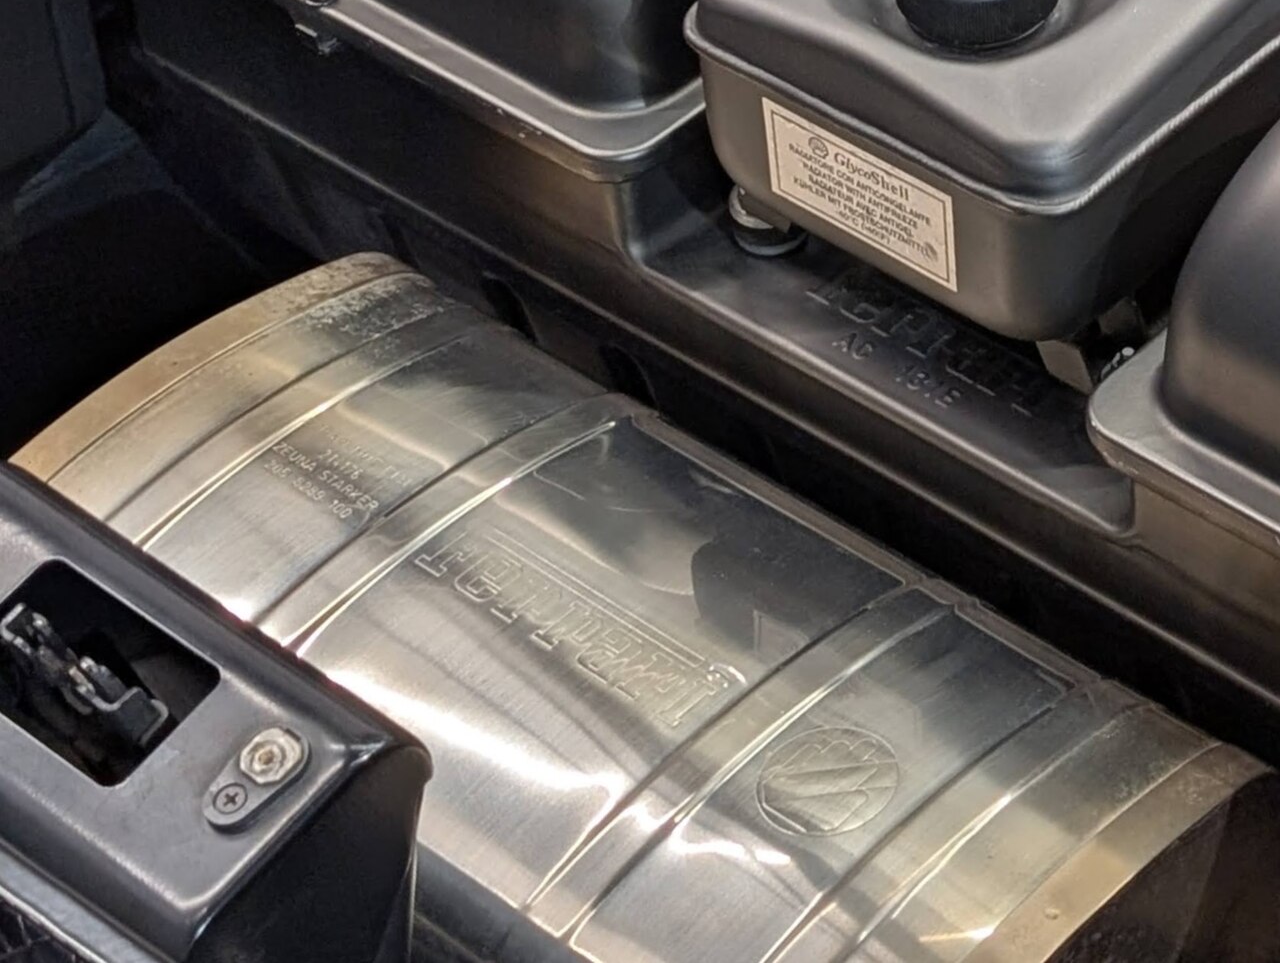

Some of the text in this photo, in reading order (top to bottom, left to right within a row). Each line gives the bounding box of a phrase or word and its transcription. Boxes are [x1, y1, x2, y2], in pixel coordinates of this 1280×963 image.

[832, 148, 909, 202] GlycoShell
[835, 167, 854, 185] CON
[801, 160, 918, 230] RADIATOR WITH ANTIFREEZE
[807, 173, 914, 239] RADIATEUR AVEC ANTIGEL
[826, 193, 841, 208] MIT
[271, 441, 318, 472] ZEUNA
[327, 498, 354, 520] 100
